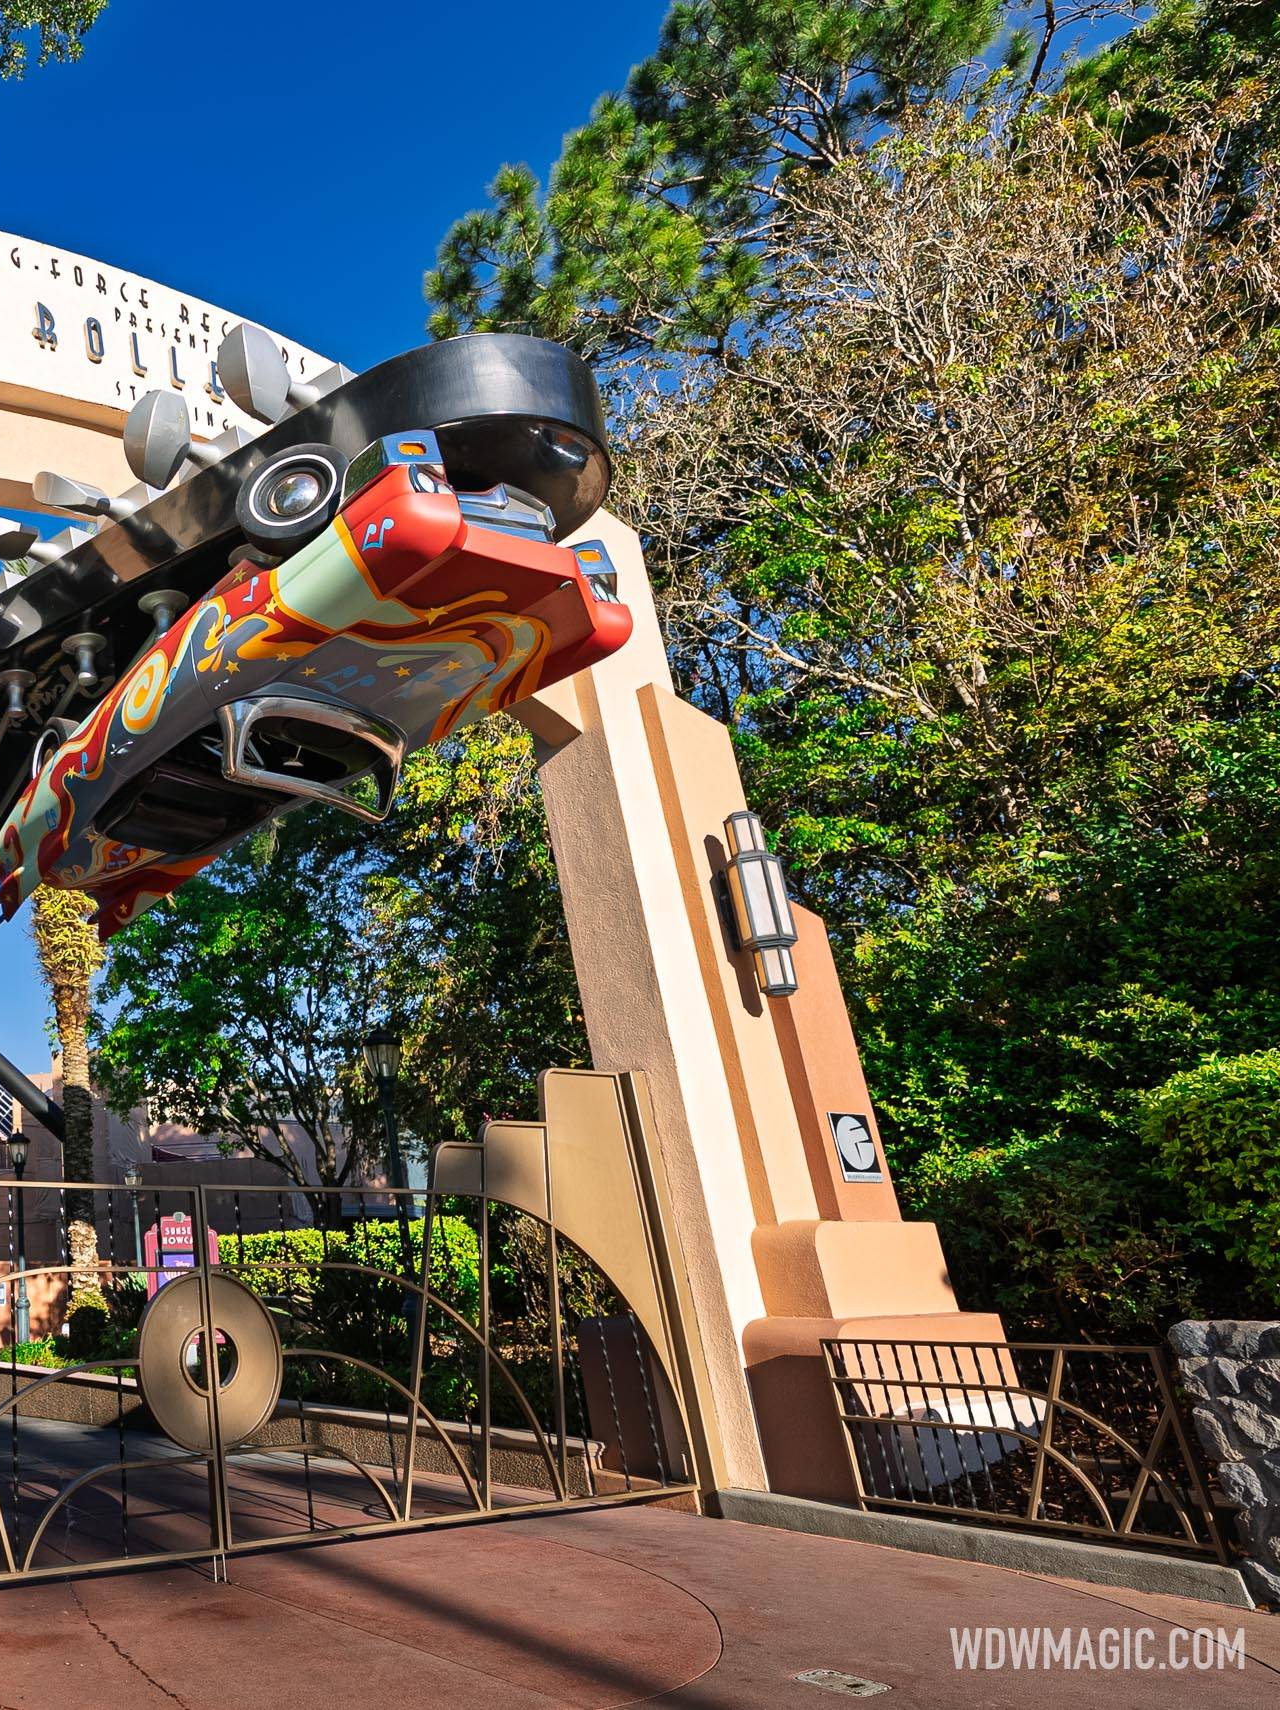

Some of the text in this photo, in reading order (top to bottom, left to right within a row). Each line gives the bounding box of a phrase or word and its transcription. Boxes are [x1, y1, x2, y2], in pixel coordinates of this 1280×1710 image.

[31, 300, 226, 405] ROLLE
[114, 306, 221, 354] PRESENT
[179, 302, 305, 375] RECDS
[115, 380, 229, 431] STING
[164, 1226, 191, 1235] SUNSE
